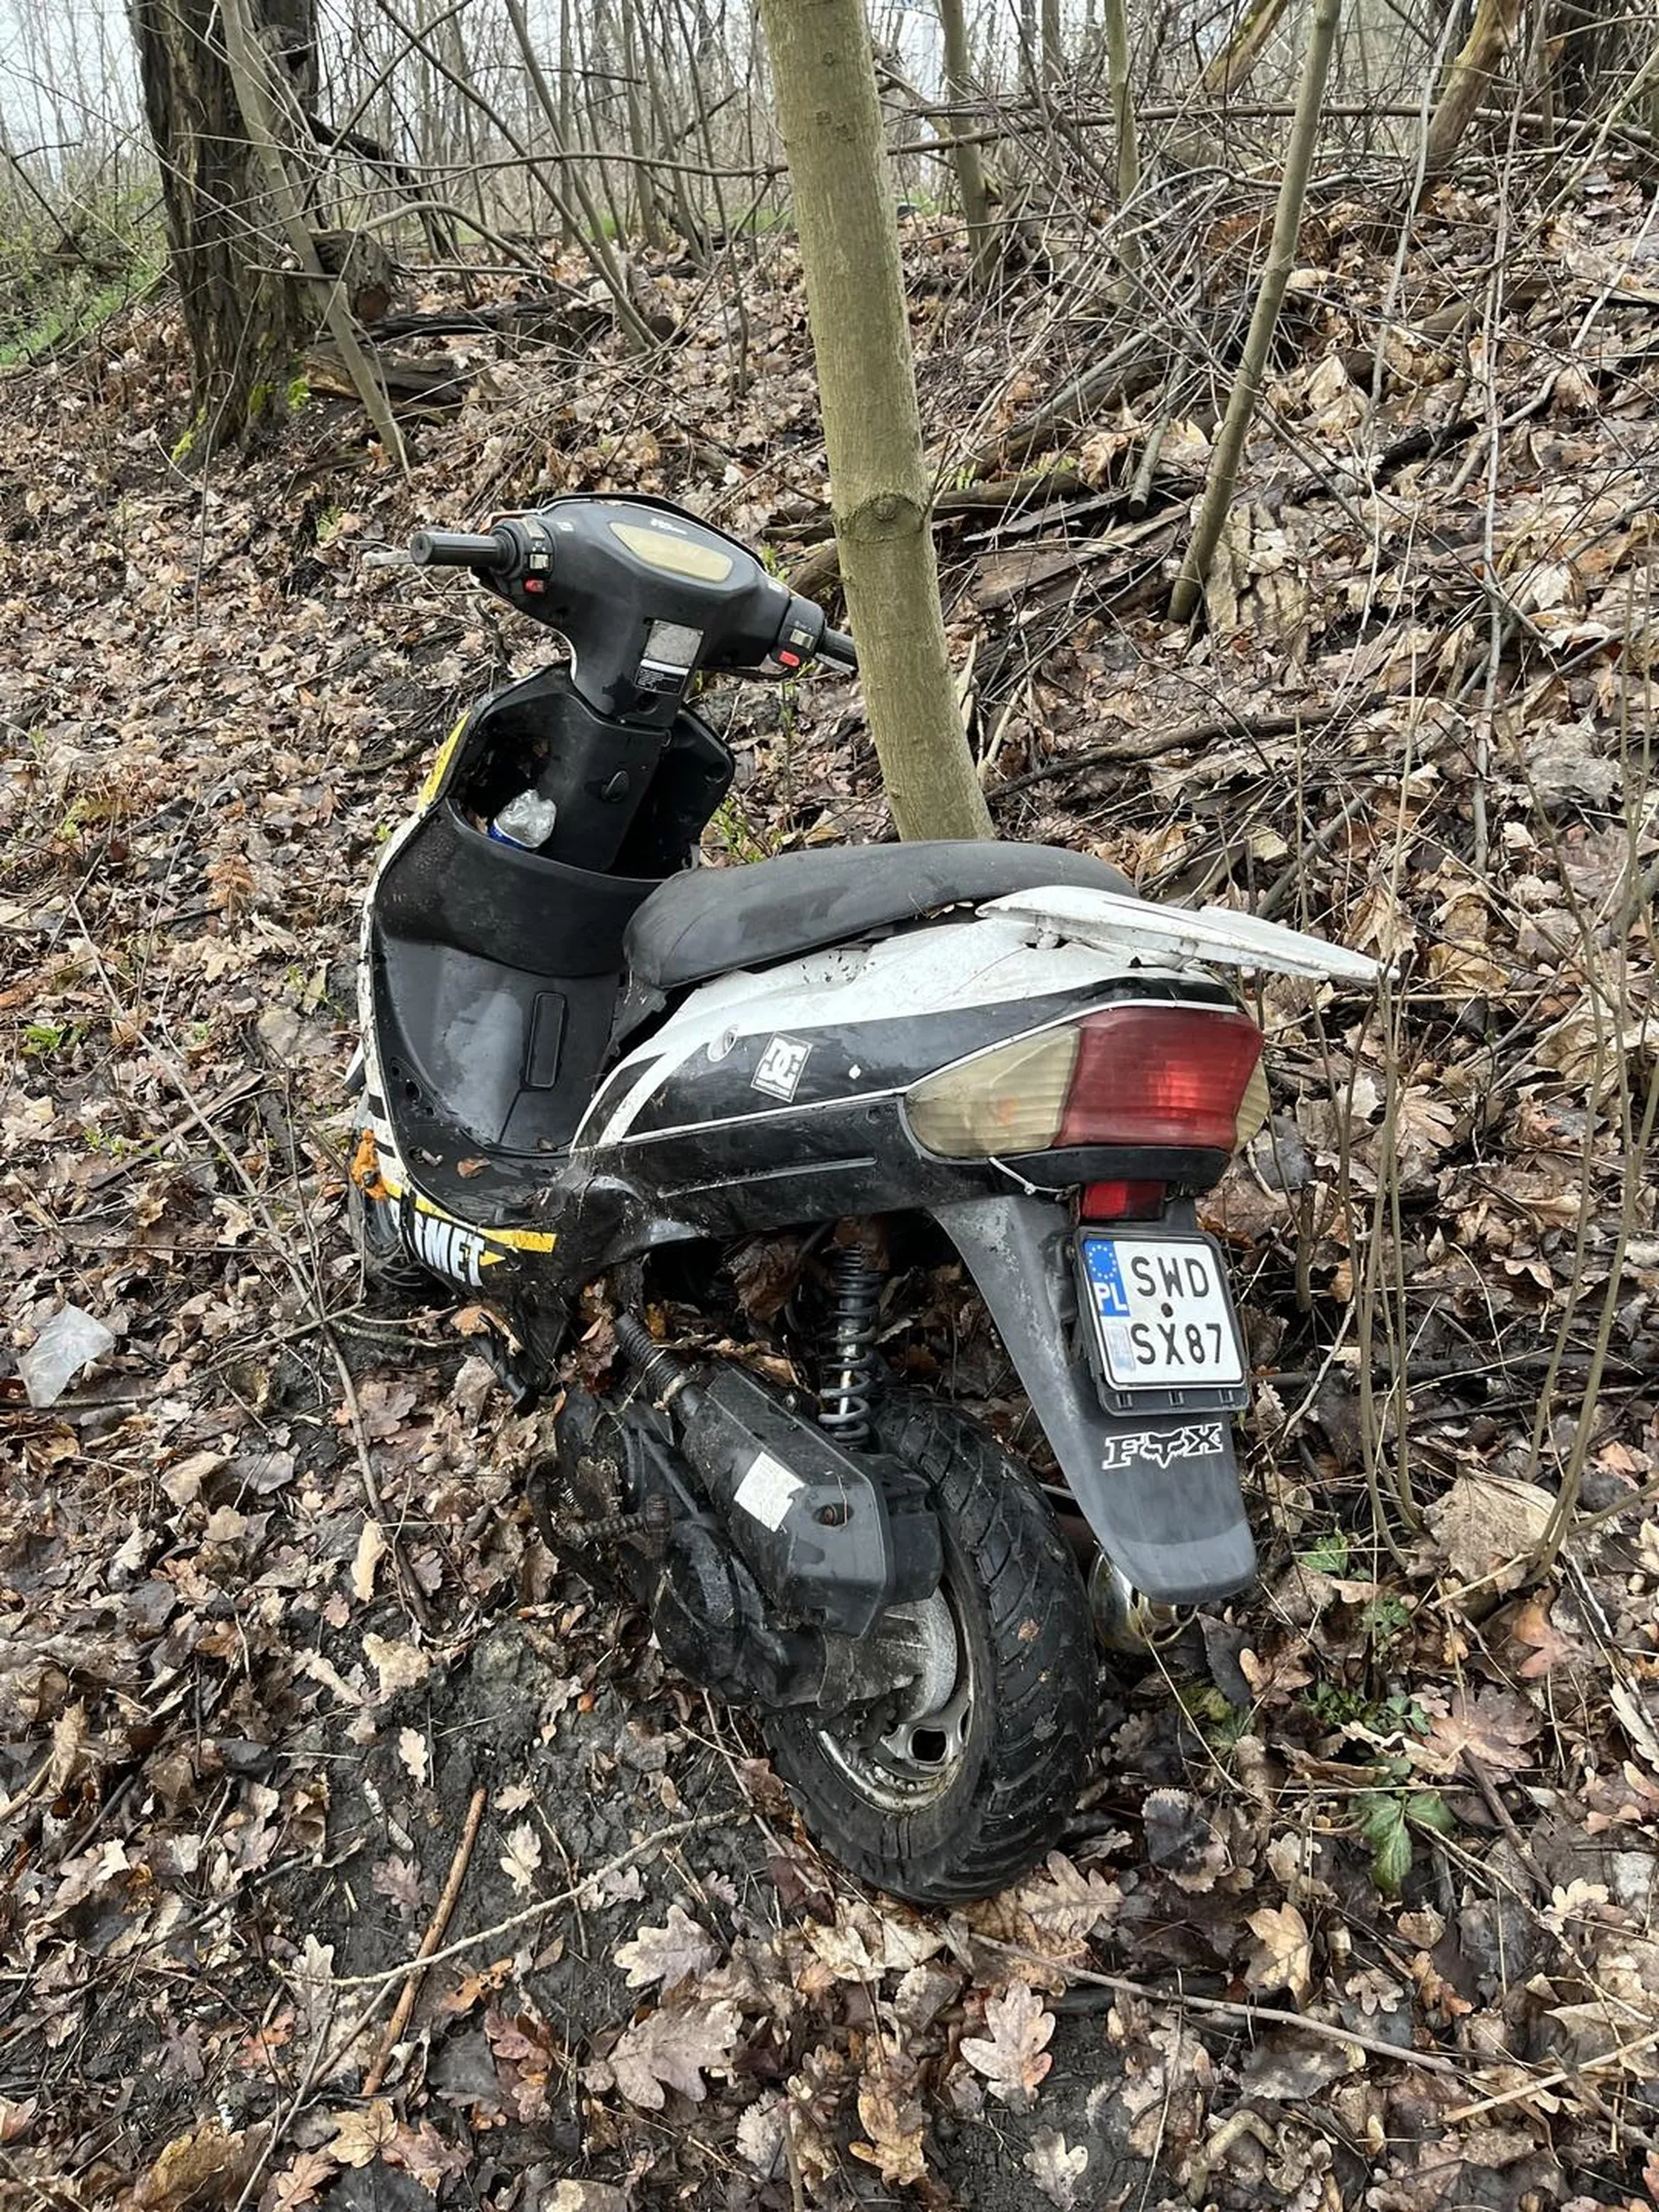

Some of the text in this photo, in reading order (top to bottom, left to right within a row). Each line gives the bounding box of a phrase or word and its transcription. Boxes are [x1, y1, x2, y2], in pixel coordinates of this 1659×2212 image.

[1094, 1283, 1128, 1312] PL
[1130, 1256, 1210, 1298] SWD
[1131, 1323, 1223, 1365] SX87
